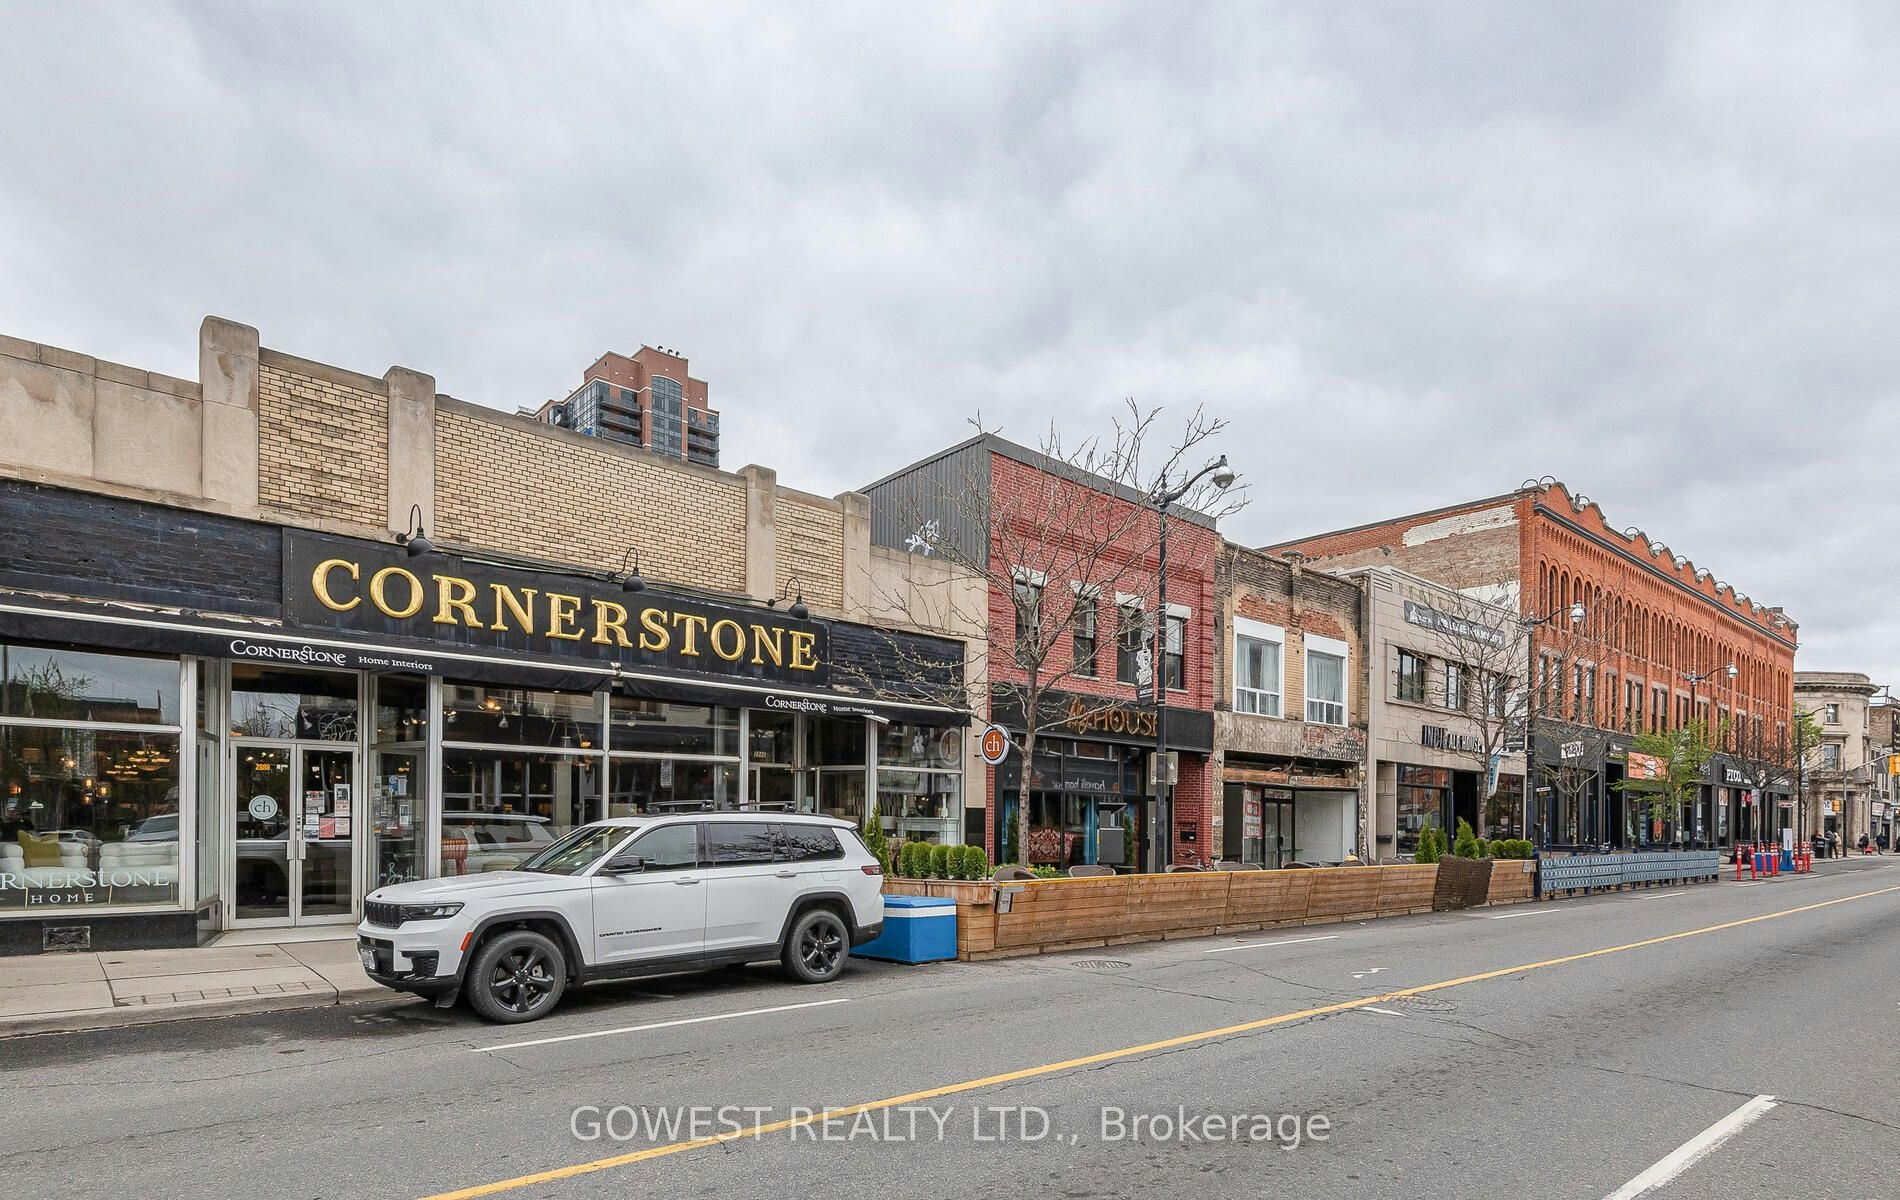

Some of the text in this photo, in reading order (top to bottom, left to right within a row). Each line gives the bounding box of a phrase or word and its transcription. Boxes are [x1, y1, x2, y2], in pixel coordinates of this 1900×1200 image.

[311, 558, 818, 672] CORNERSTONE
[358, 656, 389, 666] Home
[391, 659, 433, 671] Interiors
[985, 735, 1000, 752] ch
[253, 800, 272, 813] ch
[30, 892, 95, 904] HOME
[625, 927, 663, 935] CHEROKEE
